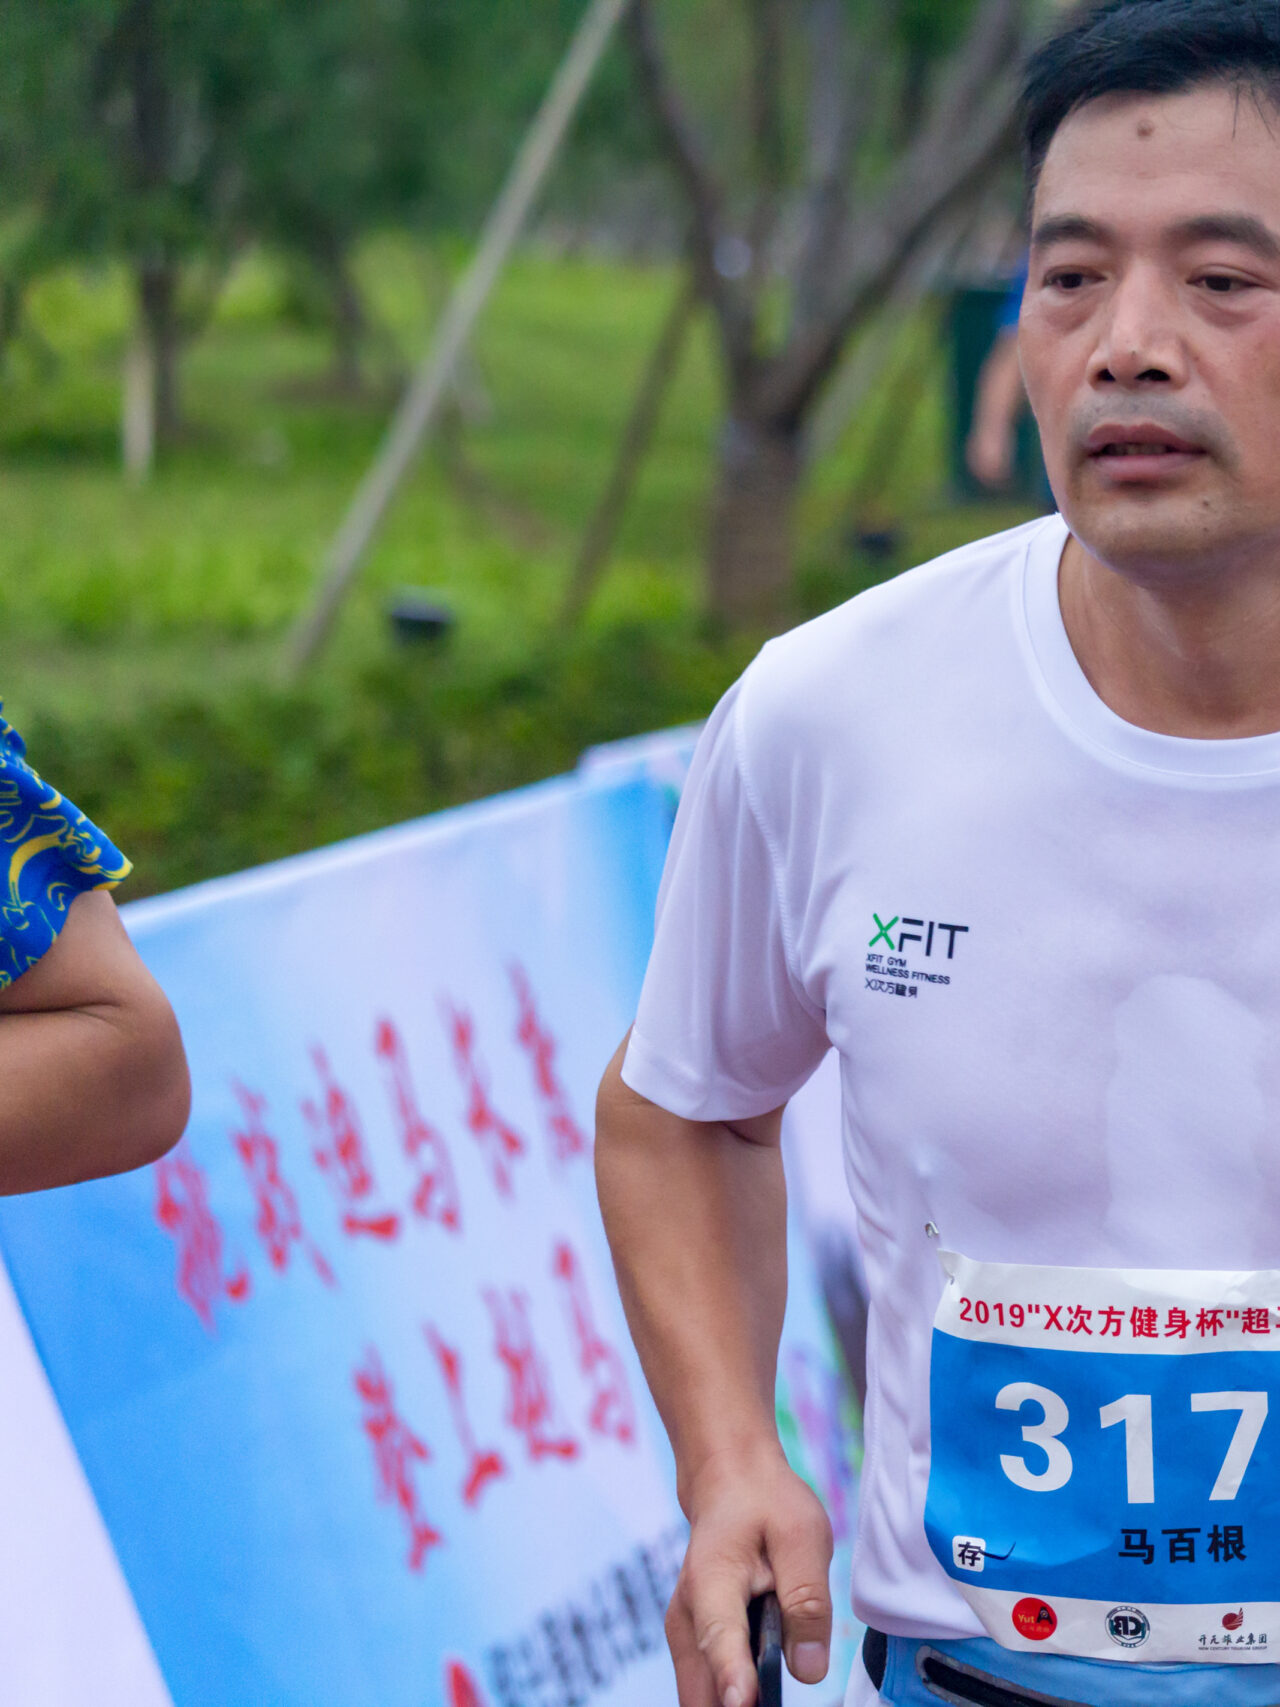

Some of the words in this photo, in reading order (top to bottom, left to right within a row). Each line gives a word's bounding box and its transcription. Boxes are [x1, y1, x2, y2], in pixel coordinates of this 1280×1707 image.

[868, 913, 969, 959] XFIT
[866, 953, 883, 964] XFIT
[887, 956, 907, 967] GYM
[865, 963, 910, 979] WELLNESS
[911, 971, 951, 985] FITNESS
[957, 1541, 983, 1567] 存
[1118, 1524, 1247, 1566] 马百根
